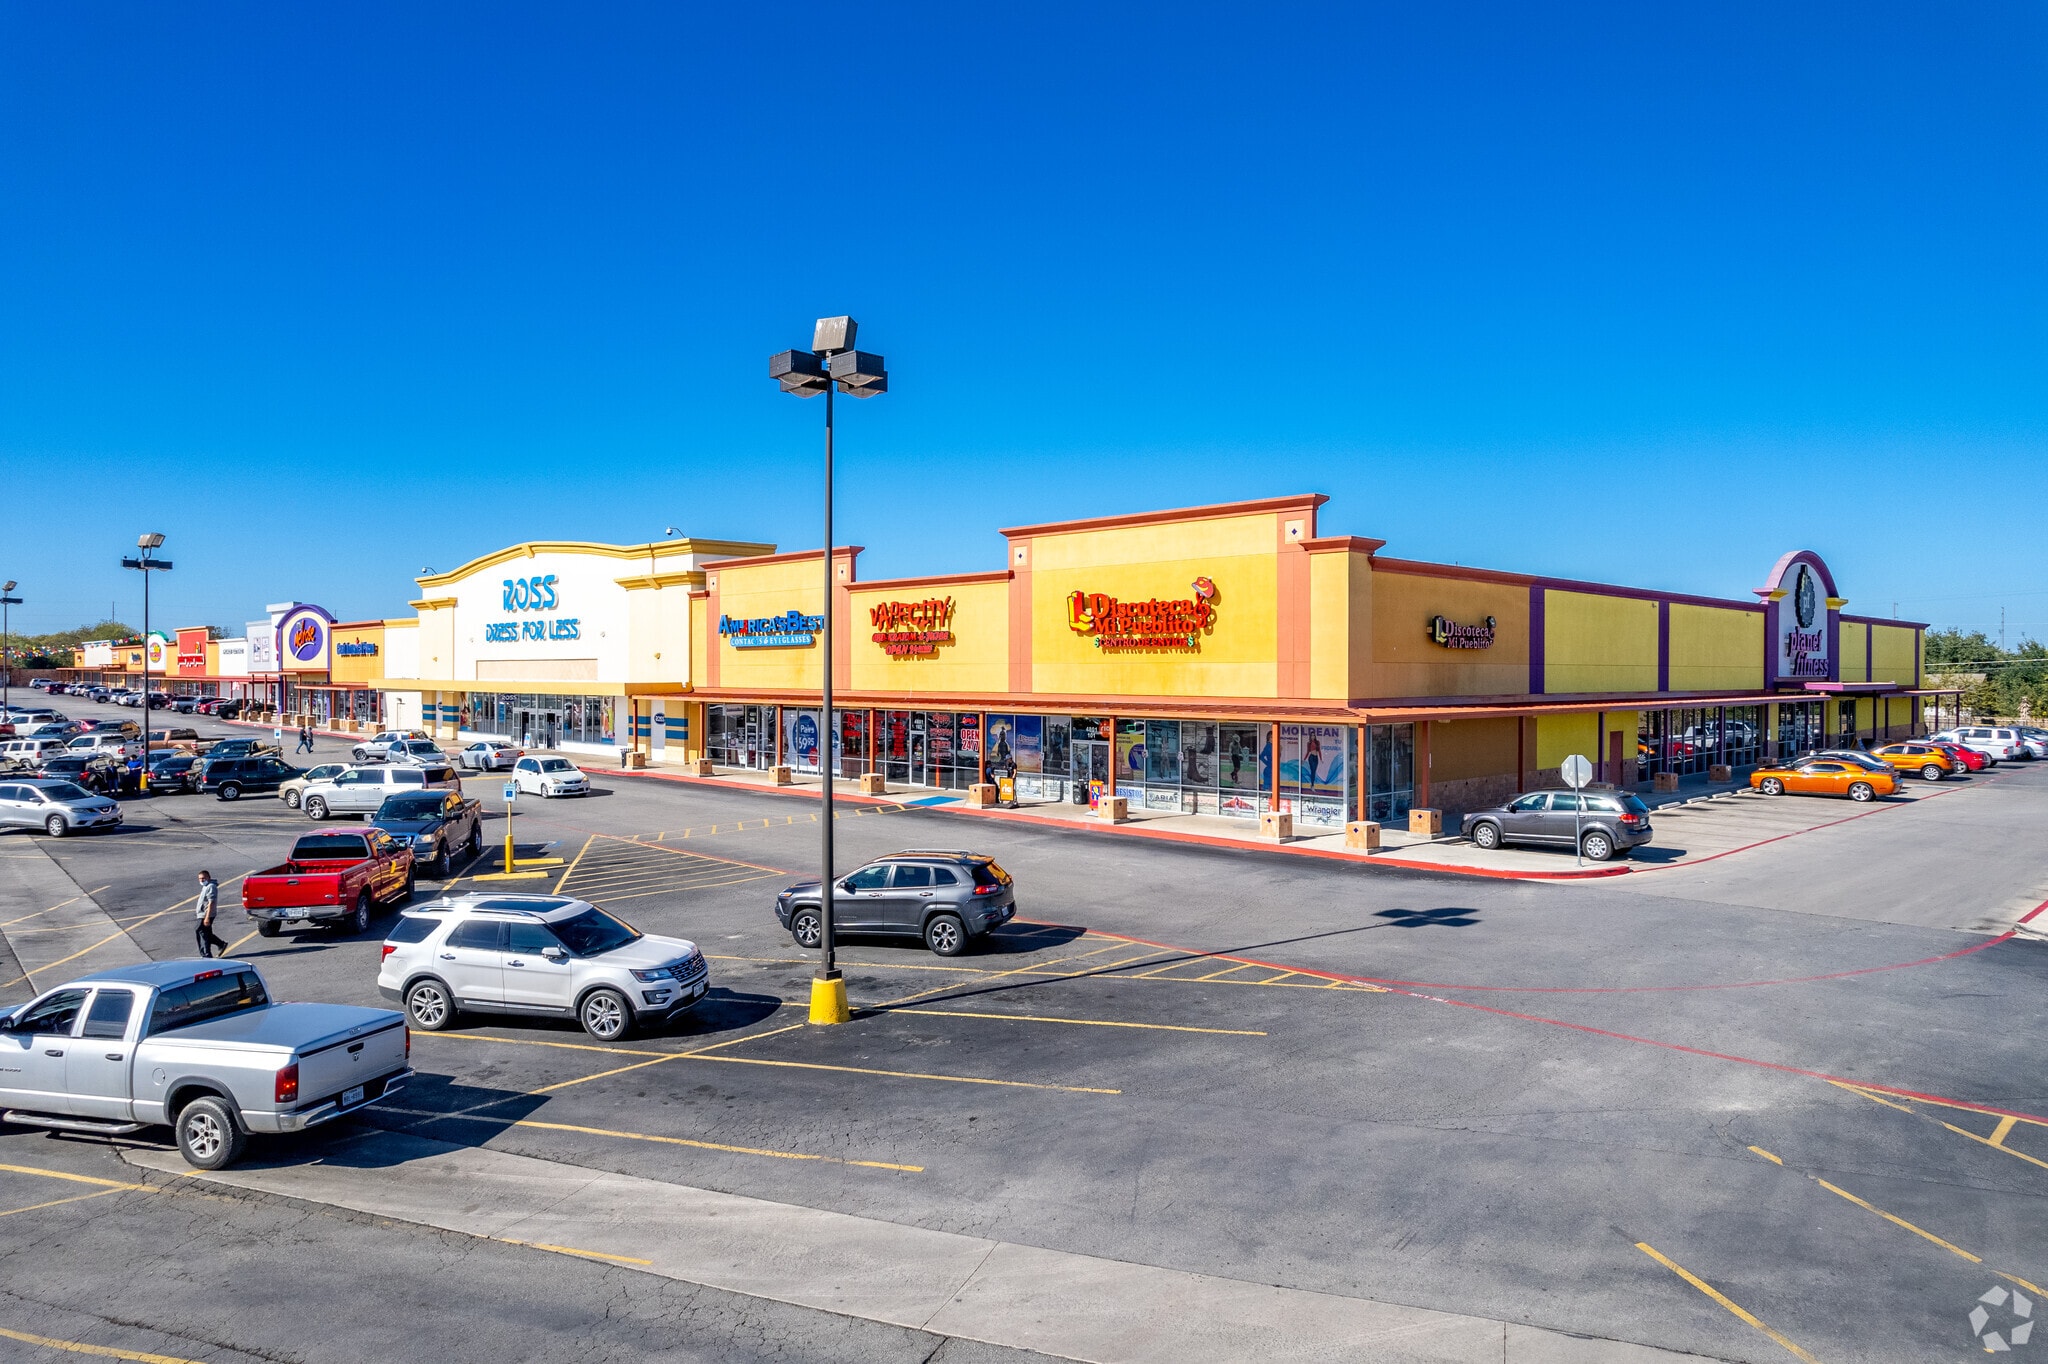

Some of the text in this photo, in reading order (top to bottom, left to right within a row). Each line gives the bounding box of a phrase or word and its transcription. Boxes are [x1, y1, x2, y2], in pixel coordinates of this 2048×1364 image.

[503, 575, 555, 610] ROSS
[1088, 593, 1194, 618] Discoteca
[787, 610, 824, 632] BEST
[1094, 615, 1195, 635] Mi Pueblito
[1446, 620, 1489, 637] Discoteca
[486, 618, 578, 641] DRESS FOR LESS
[770, 634, 811, 644] EYEGLASSES
[1137, 638, 1150, 647] DE
[1448, 637, 1490, 649] Mi Pueblito
[1790, 627, 1823, 657] planet
[886, 644, 908, 655] OPEN
[1795, 650, 1829, 676] fitness
[961, 729, 979, 740] OPEN
[962, 740, 979, 751] 24/7
[1002, 784, 1012, 793] ria
[1307, 804, 1341, 818] Wrangler
